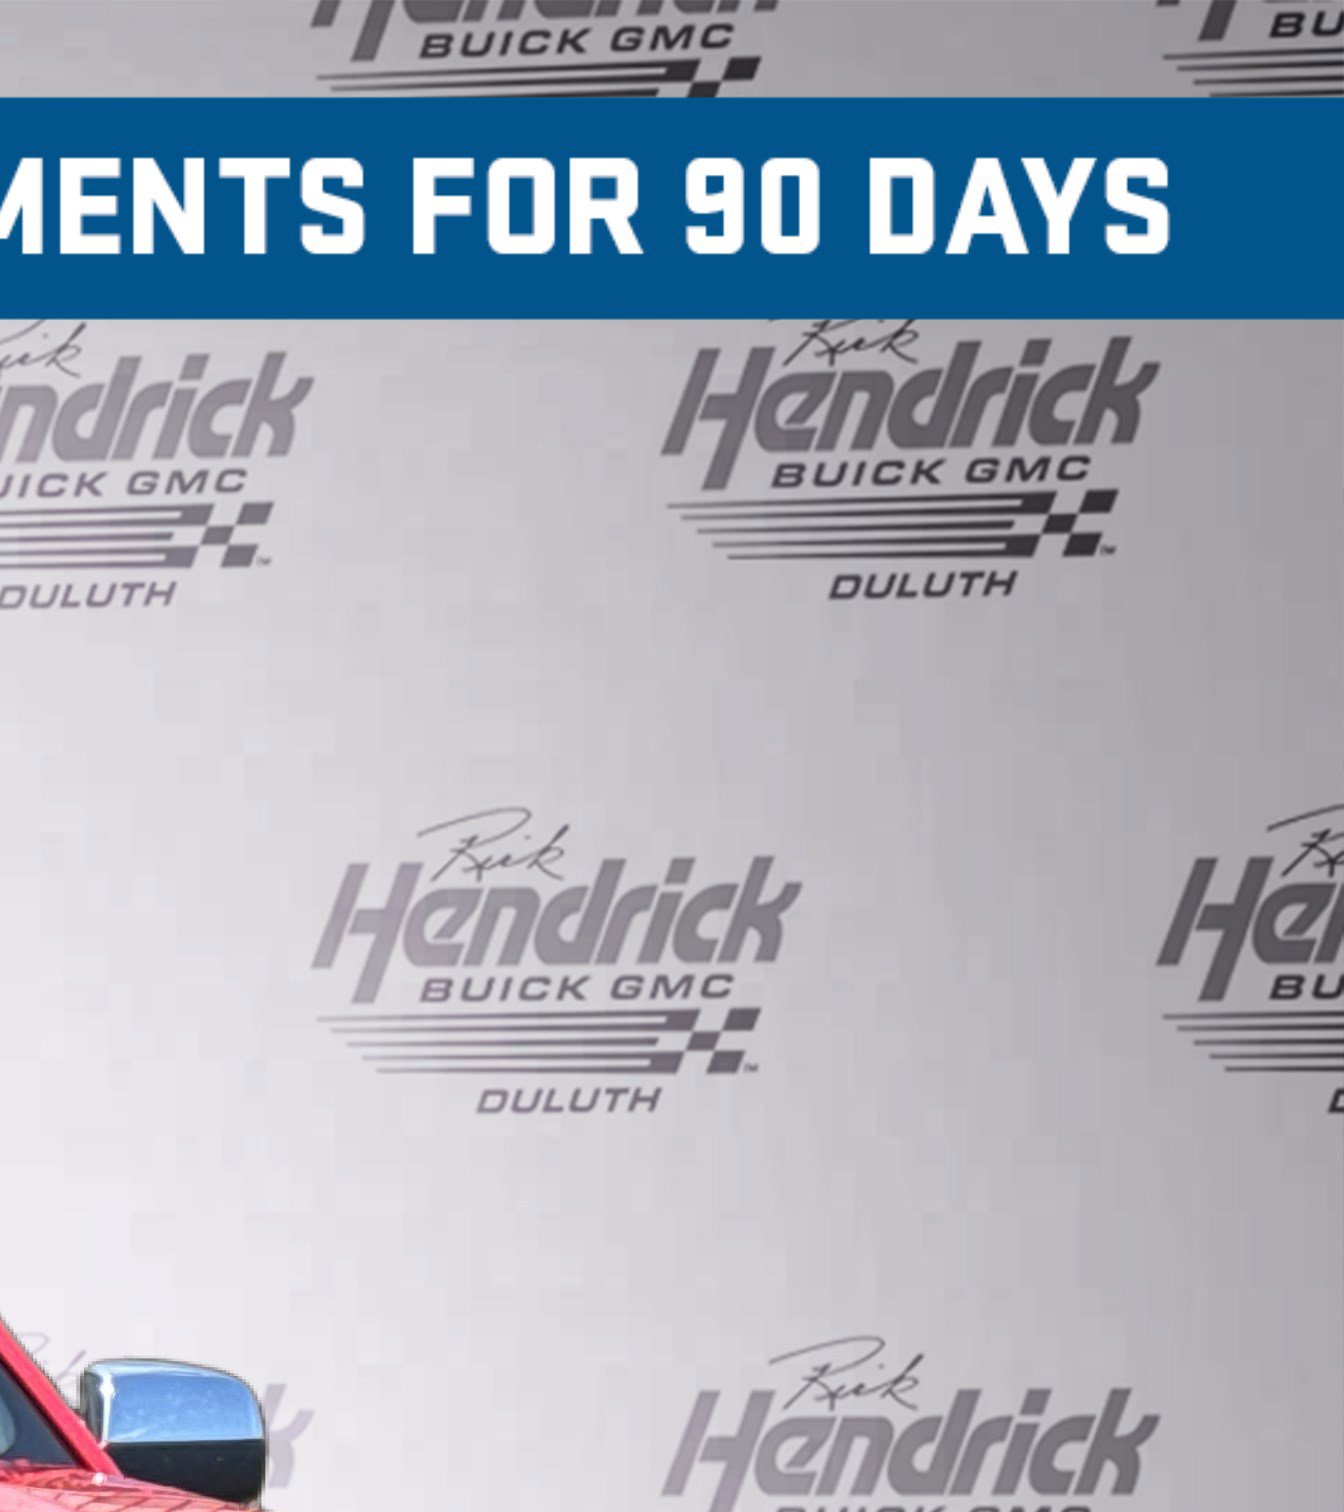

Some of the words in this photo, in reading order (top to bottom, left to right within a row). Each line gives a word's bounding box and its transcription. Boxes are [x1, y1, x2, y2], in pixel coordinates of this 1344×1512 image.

[419, 28, 592, 58] BUICK
[609, 24, 734, 50] GMC
[659, 336, 1162, 491] Hendrick
[125, 468, 248, 496] GMC
[770, 459, 945, 489] BUICK
[963, 455, 1092, 484] GMC
[827, 570, 1018, 601] DULUTH
[311, 855, 803, 1004] Hendrick
[420, 977, 592, 1003] BUICK
[609, 974, 733, 1001] GMC
[475, 1087, 663, 1115] DULUTH
